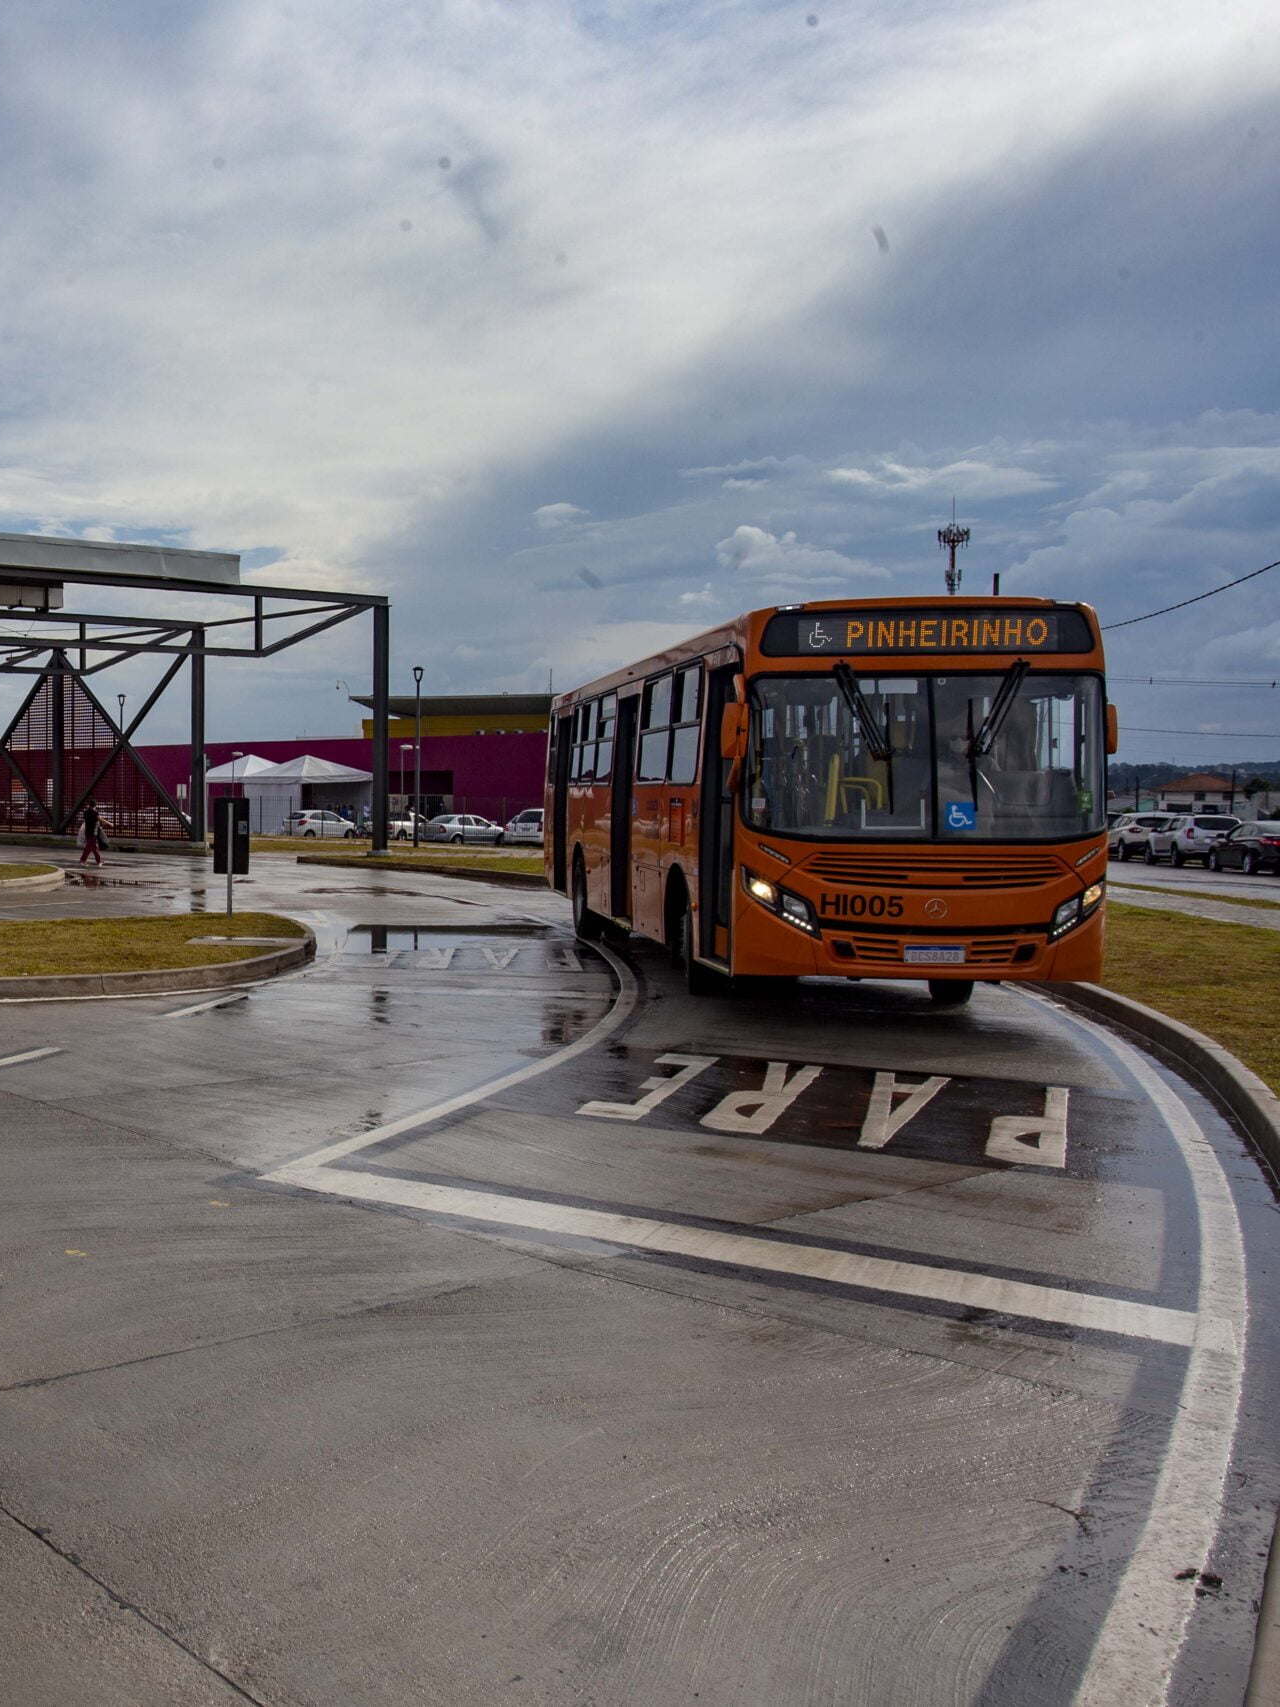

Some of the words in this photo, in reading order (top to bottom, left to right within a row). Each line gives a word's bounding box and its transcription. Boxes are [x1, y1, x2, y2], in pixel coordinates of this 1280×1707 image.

[846, 618, 1049, 648] PINHEIRINHO
[820, 893, 905, 917] HI005
[575, 1053, 1071, 1168] PARE
